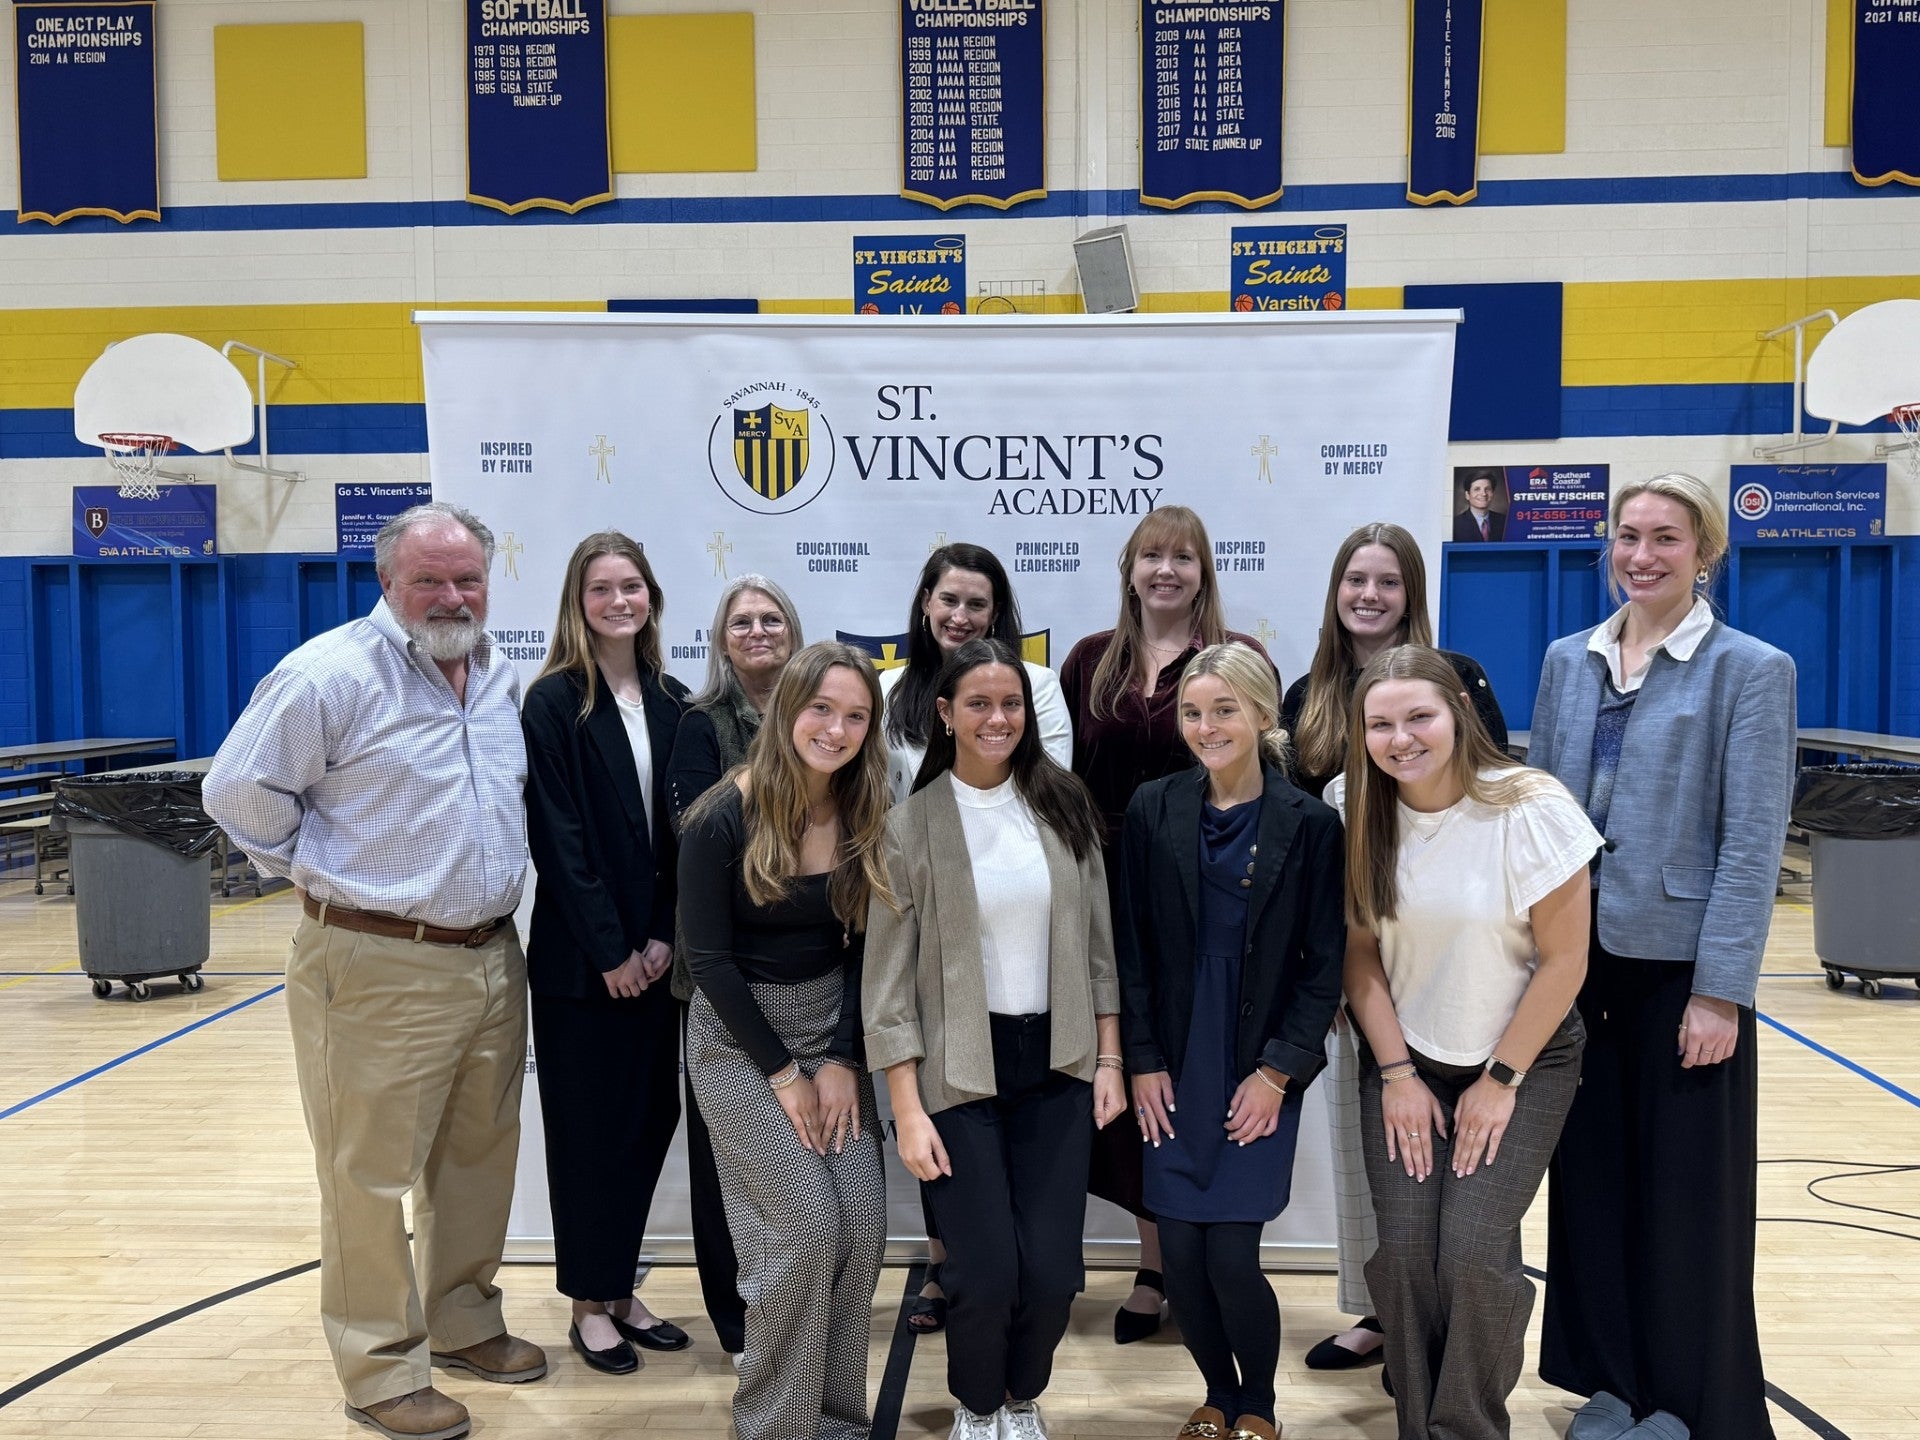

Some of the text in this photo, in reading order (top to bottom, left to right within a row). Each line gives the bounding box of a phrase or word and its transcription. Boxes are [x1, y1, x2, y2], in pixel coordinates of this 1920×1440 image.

[481, 0, 586, 20] SOFTBALL
[1156, 7, 1270, 24] CHAMPIONSHIPS
[1865, 10, 1892, 23] 2021
[36, 16, 134, 32] ONE ACT PLAY
[916, 12, 1027, 27] CHAMPIONSHIPS
[482, 20, 589, 37] CHAMPIONSHIPS
[1155, 28, 1241, 41] 2009 A/AA AREA
[28, 32, 142, 48] CHAMPIONSHIPS
[908, 36, 995, 48] 1998 AAAA REGION
[474, 44, 555, 56] 1979 GISA REGION
[909, 49, 996, 61] 1999 AAAA REGION
[1155, 42, 1241, 55] 2012 AA AREA
[30, 52, 106, 64] 2014 AA REGION
[475, 56, 556, 68] 1981 GISA REGION
[1156, 55, 1241, 69] 2013 AA AREA
[909, 62, 1000, 73] 2000 AAAAA REGION
[475, 69, 557, 81] 1985 GISA REGION
[910, 75, 1001, 86] 2001 AAAAA REGION
[1157, 68, 1241, 82] 2014 AA AREA
[475, 82, 553, 94] 1985 GISA STATE
[910, 88, 1001, 100] 2002 AAAAA REGION
[1157, 82, 1242, 96] 2015 AA AREA
[514, 95, 561, 106] RUNNER-UP
[1158, 95, 1242, 109] 2016 AA AREA
[911, 102, 1002, 113] 2003 AAAAA REGION
[911, 115, 998, 126] 2003 AAAAA STATE
[1158, 109, 1245, 123] 2016 AA STATE
[1435, 113, 1456, 125] 2003
[911, 128, 1002, 140] 2004 AAA REGION
[1158, 123, 1240, 137] 2017 AA AREA
[1436, 127, 1455, 138] 2016
[911, 141, 1003, 153] 2005 AAA REGION
[1158, 138, 1262, 151] 2017 STATE RUNNER UP
[911, 155, 1004, 167] 2006 AAA REGION
[911, 168, 1005, 180] 2007 AAA REGION
[1232, 239, 1343, 255] ST. VINCENT'S
[855, 249, 963, 264] ST. VINCENT'S
[1245, 260, 1331, 285] Saints
[868, 270, 951, 294] Saints
[1257, 296, 1320, 311] Varsity
[723, 382, 820, 408] SAVANNAH 1845
[877, 385, 936, 421] ST.
[481, 442, 532, 456] INSPIRED
[1321, 444, 1387, 458] COMPELLED
[843, 435, 1164, 481] VINCENT'S
[482, 460, 532, 473] BY FAITH
[1325, 461, 1383, 475] BY MERCY
[338, 488, 351, 496] Go
[354, 487, 367, 495] St.
[370, 487, 413, 495] Vincent's
[1559, 492, 1605, 500] FISCHER
[1775, 491, 1880, 500] Distribution Services
[987, 488, 1164, 515] ACADEMY
[1745, 498, 1759, 506] DSI
[1775, 503, 1866, 512] International, Inc.
[92, 513, 103, 528] B
[1517, 510, 1601, 520] 912-656-1165
[1757, 528, 1856, 538] SVA ATHLETICS
[99, 546, 190, 556] SVA ATHLETICS
[797, 542, 870, 555] EDUCATIONAL
[1016, 542, 1079, 556] PRINCIPLED
[1215, 541, 1265, 554] INSPIRED
[809, 559, 858, 572] COURAGE
[1014, 558, 1080, 572] LEADERSHIP
[1216, 558, 1265, 571] BY FAITH
[695, 630, 702, 642] A
[672, 646, 709, 658] DIGNIT
